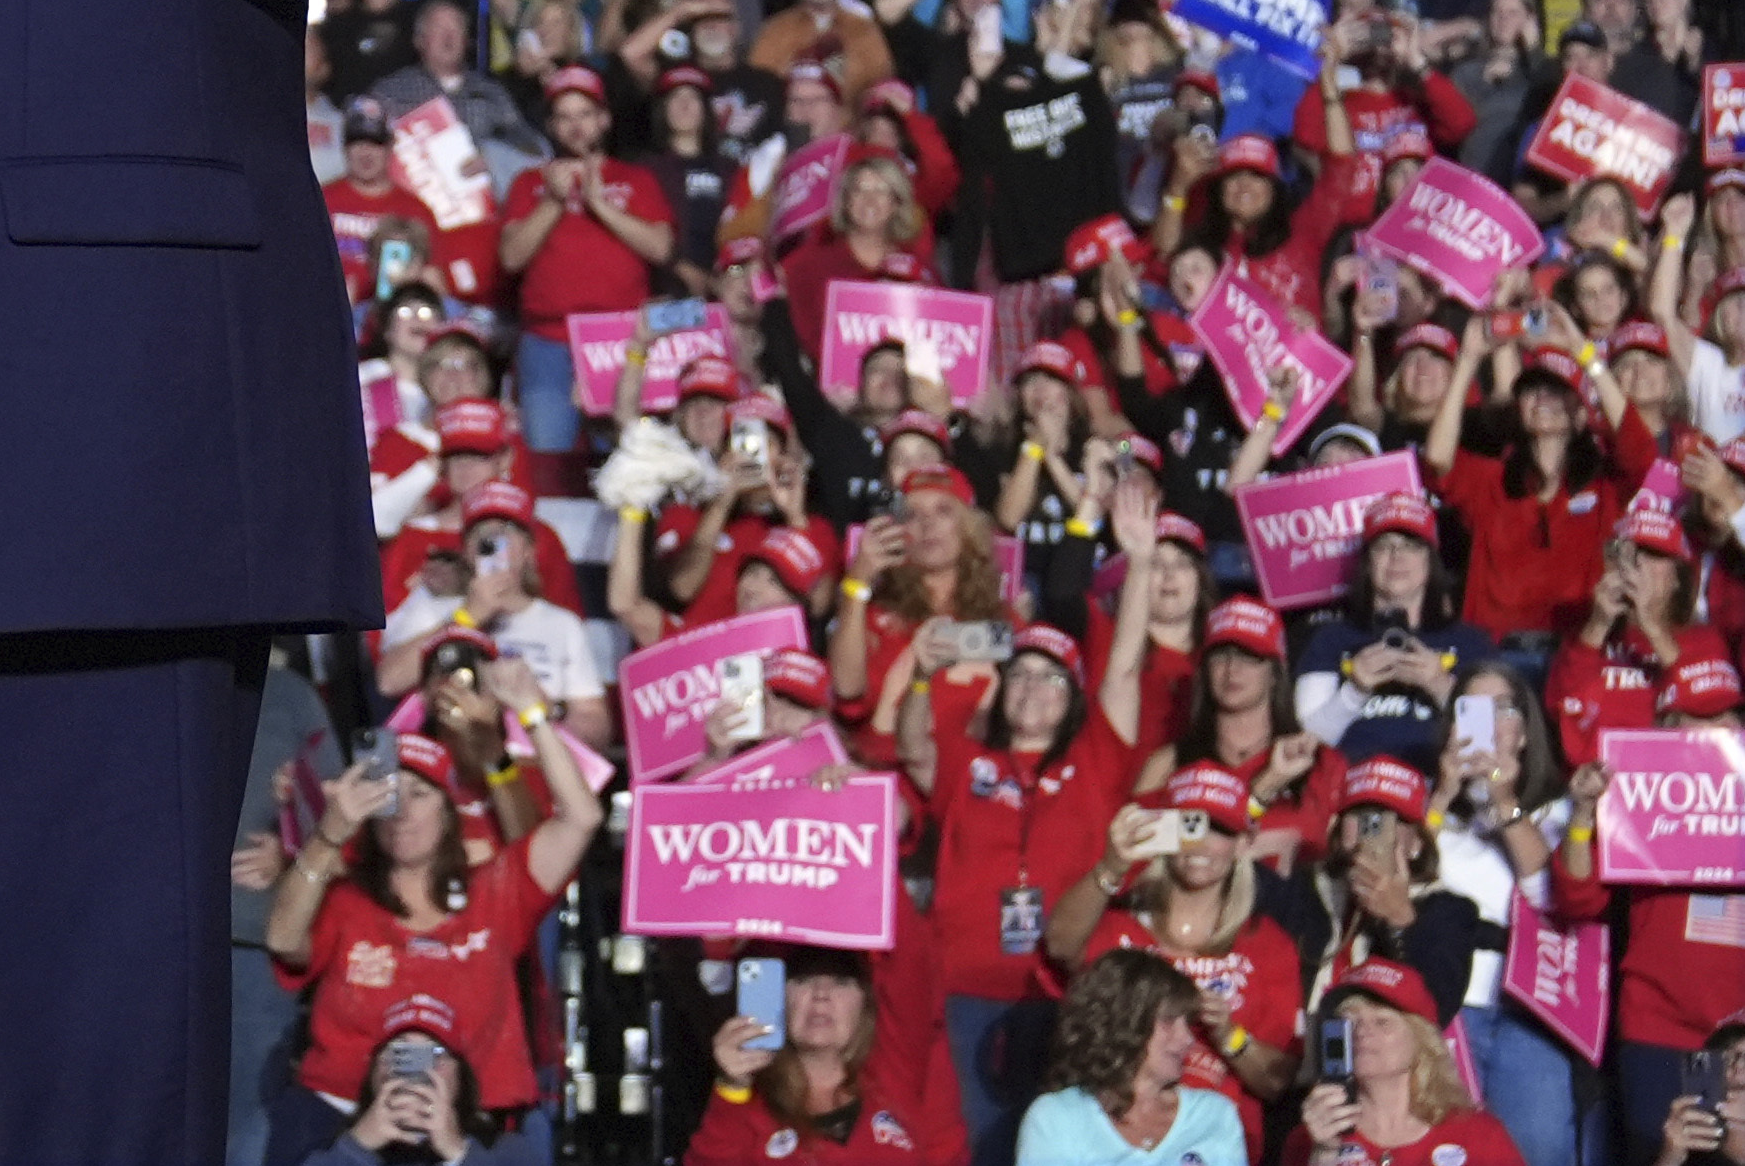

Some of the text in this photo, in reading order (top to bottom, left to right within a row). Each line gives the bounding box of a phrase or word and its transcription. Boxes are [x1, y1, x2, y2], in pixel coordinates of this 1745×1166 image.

[1560, 96, 1635, 147] DREAM
[1550, 118, 1660, 191] AGAIN!
[1409, 182, 1524, 266] WOMEN
[1615, 772, 1745, 814] WOM
[647, 818, 880, 868] WOMEN
[1645, 814, 1681, 839] for
[680, 862, 840, 893] for TRUMP
